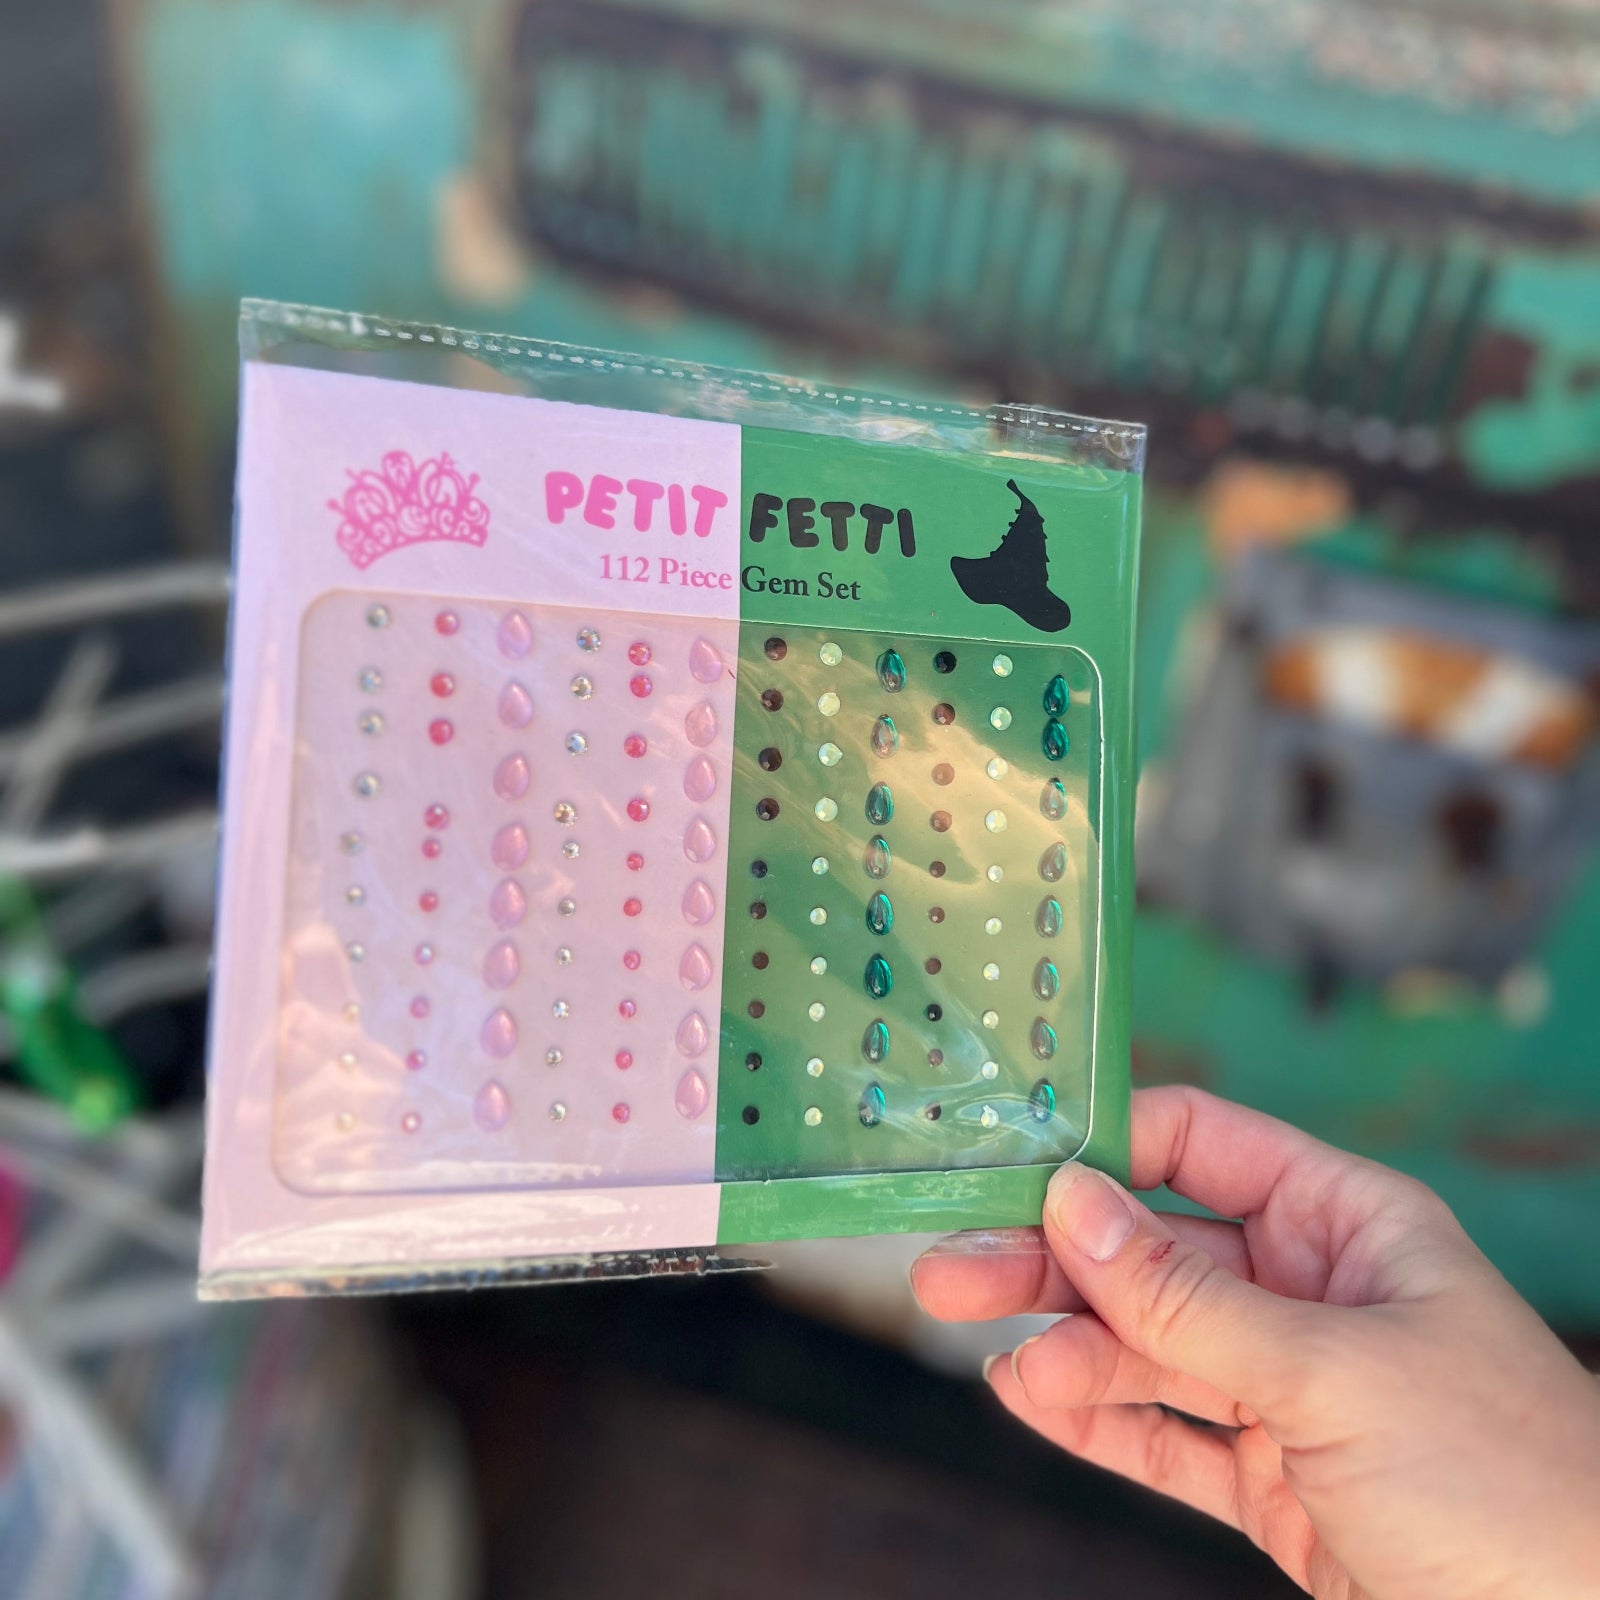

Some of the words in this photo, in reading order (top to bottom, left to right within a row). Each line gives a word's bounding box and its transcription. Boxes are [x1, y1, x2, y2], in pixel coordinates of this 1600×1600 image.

[544, 470, 728, 538] PETIT
[748, 492, 917, 558] FETTI
[599, 553, 650, 583] 112
[658, 556, 733, 590] Piece
[740, 565, 809, 597] Gem
[817, 571, 862, 601] Set
